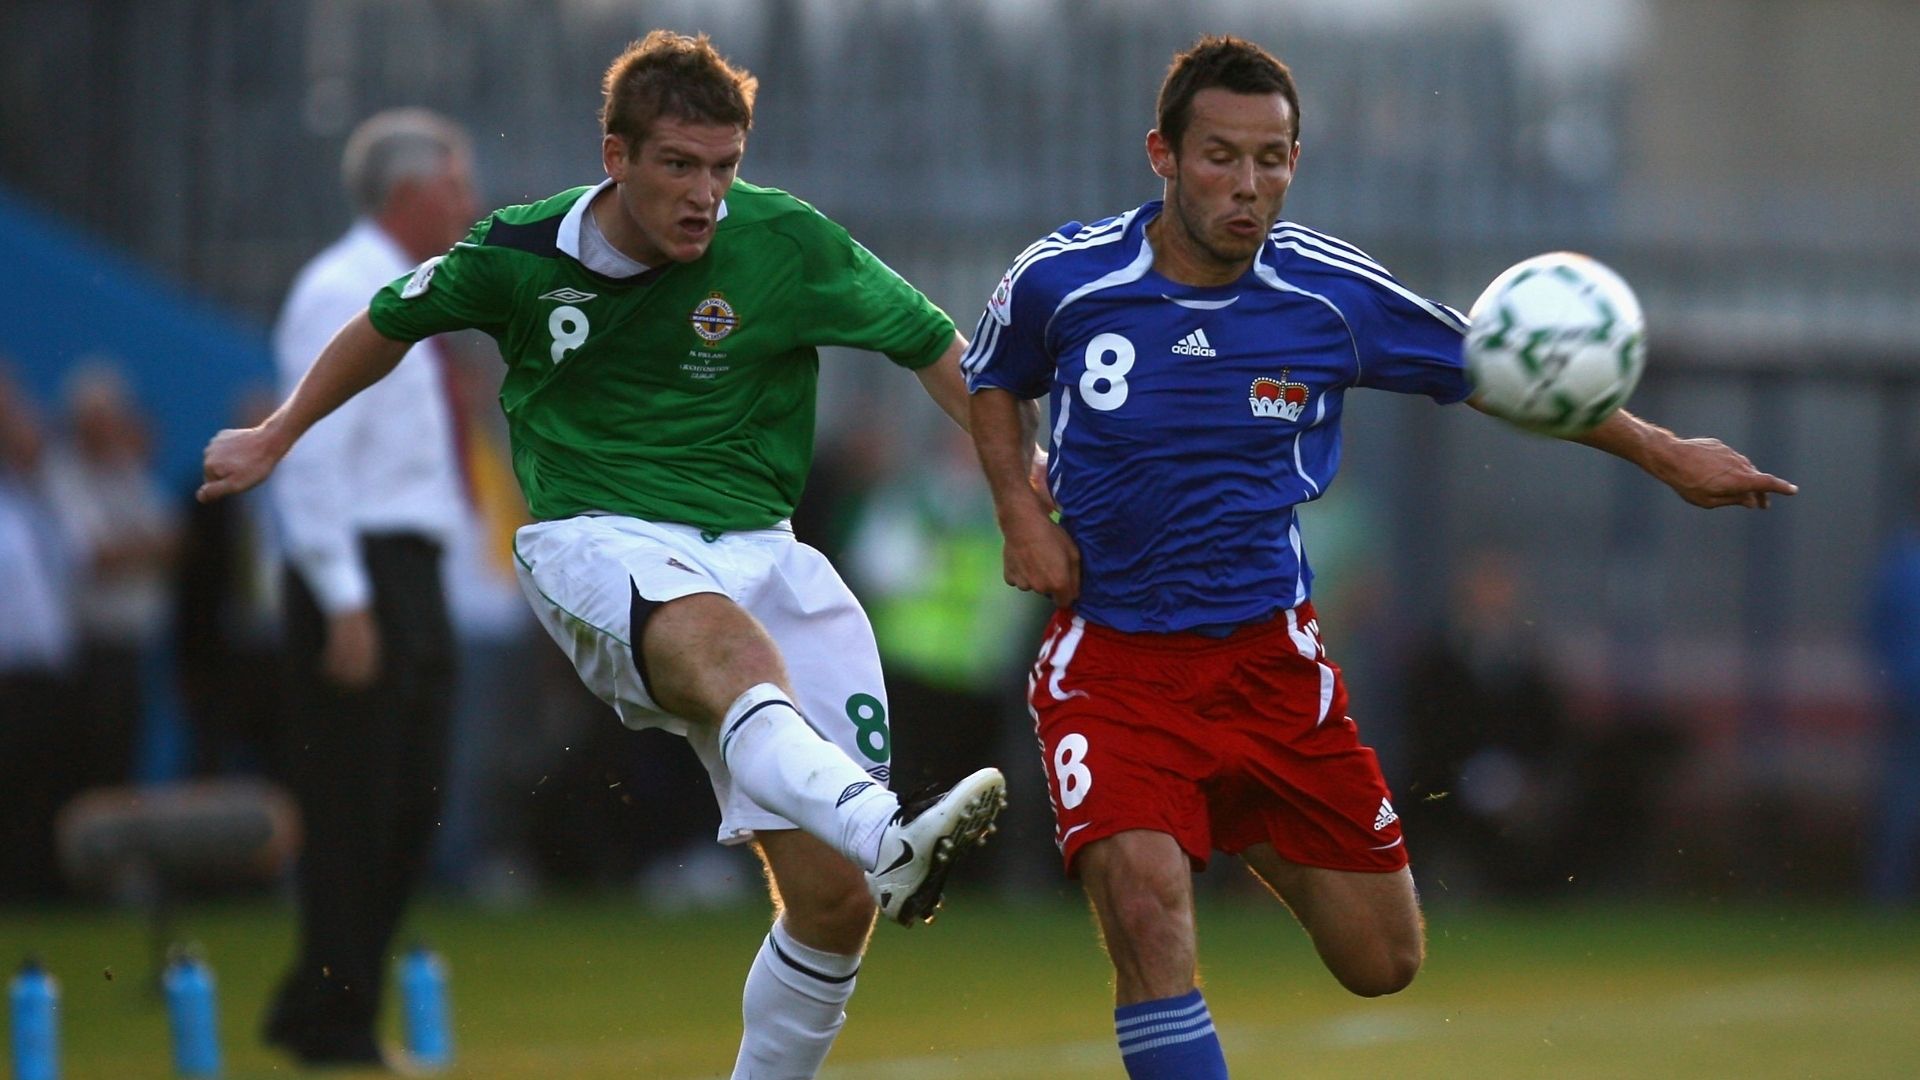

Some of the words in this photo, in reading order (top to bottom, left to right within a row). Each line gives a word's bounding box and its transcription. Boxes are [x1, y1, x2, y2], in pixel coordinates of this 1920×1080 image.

[548, 305, 590, 365] 8
[1171, 344, 1217, 357] adidas
[1079, 332, 1136, 411] 8
[845, 693, 890, 763] 8
[1054, 733, 1092, 810] 8
[1374, 812, 1399, 830] adida
